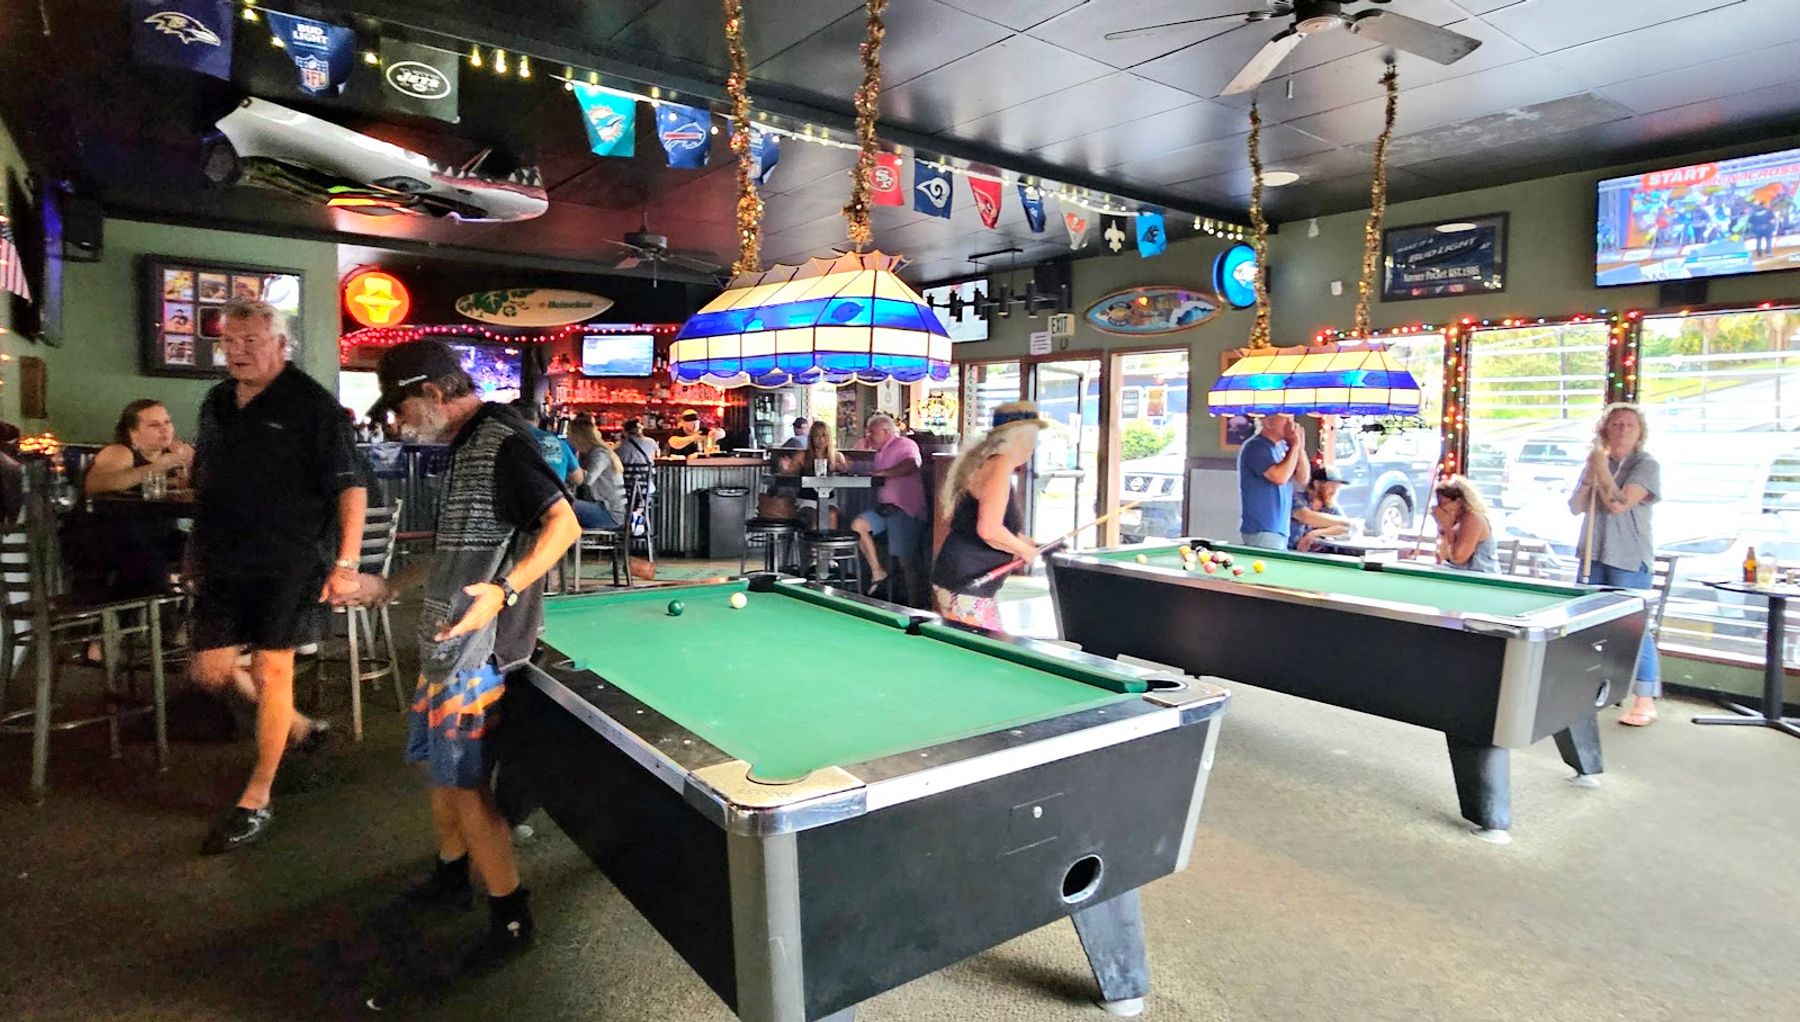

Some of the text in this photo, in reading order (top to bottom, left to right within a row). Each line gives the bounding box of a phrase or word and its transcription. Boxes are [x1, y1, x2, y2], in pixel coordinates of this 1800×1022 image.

[293, 30, 329, 44] LIGHT
[297, 23, 323, 35] BUD
[396, 71, 440, 88] JETS
[1650, 165, 1711, 186] START
[1408, 237, 1477, 263] BUD LIGHT
[1051, 316, 1067, 334] EXIT
